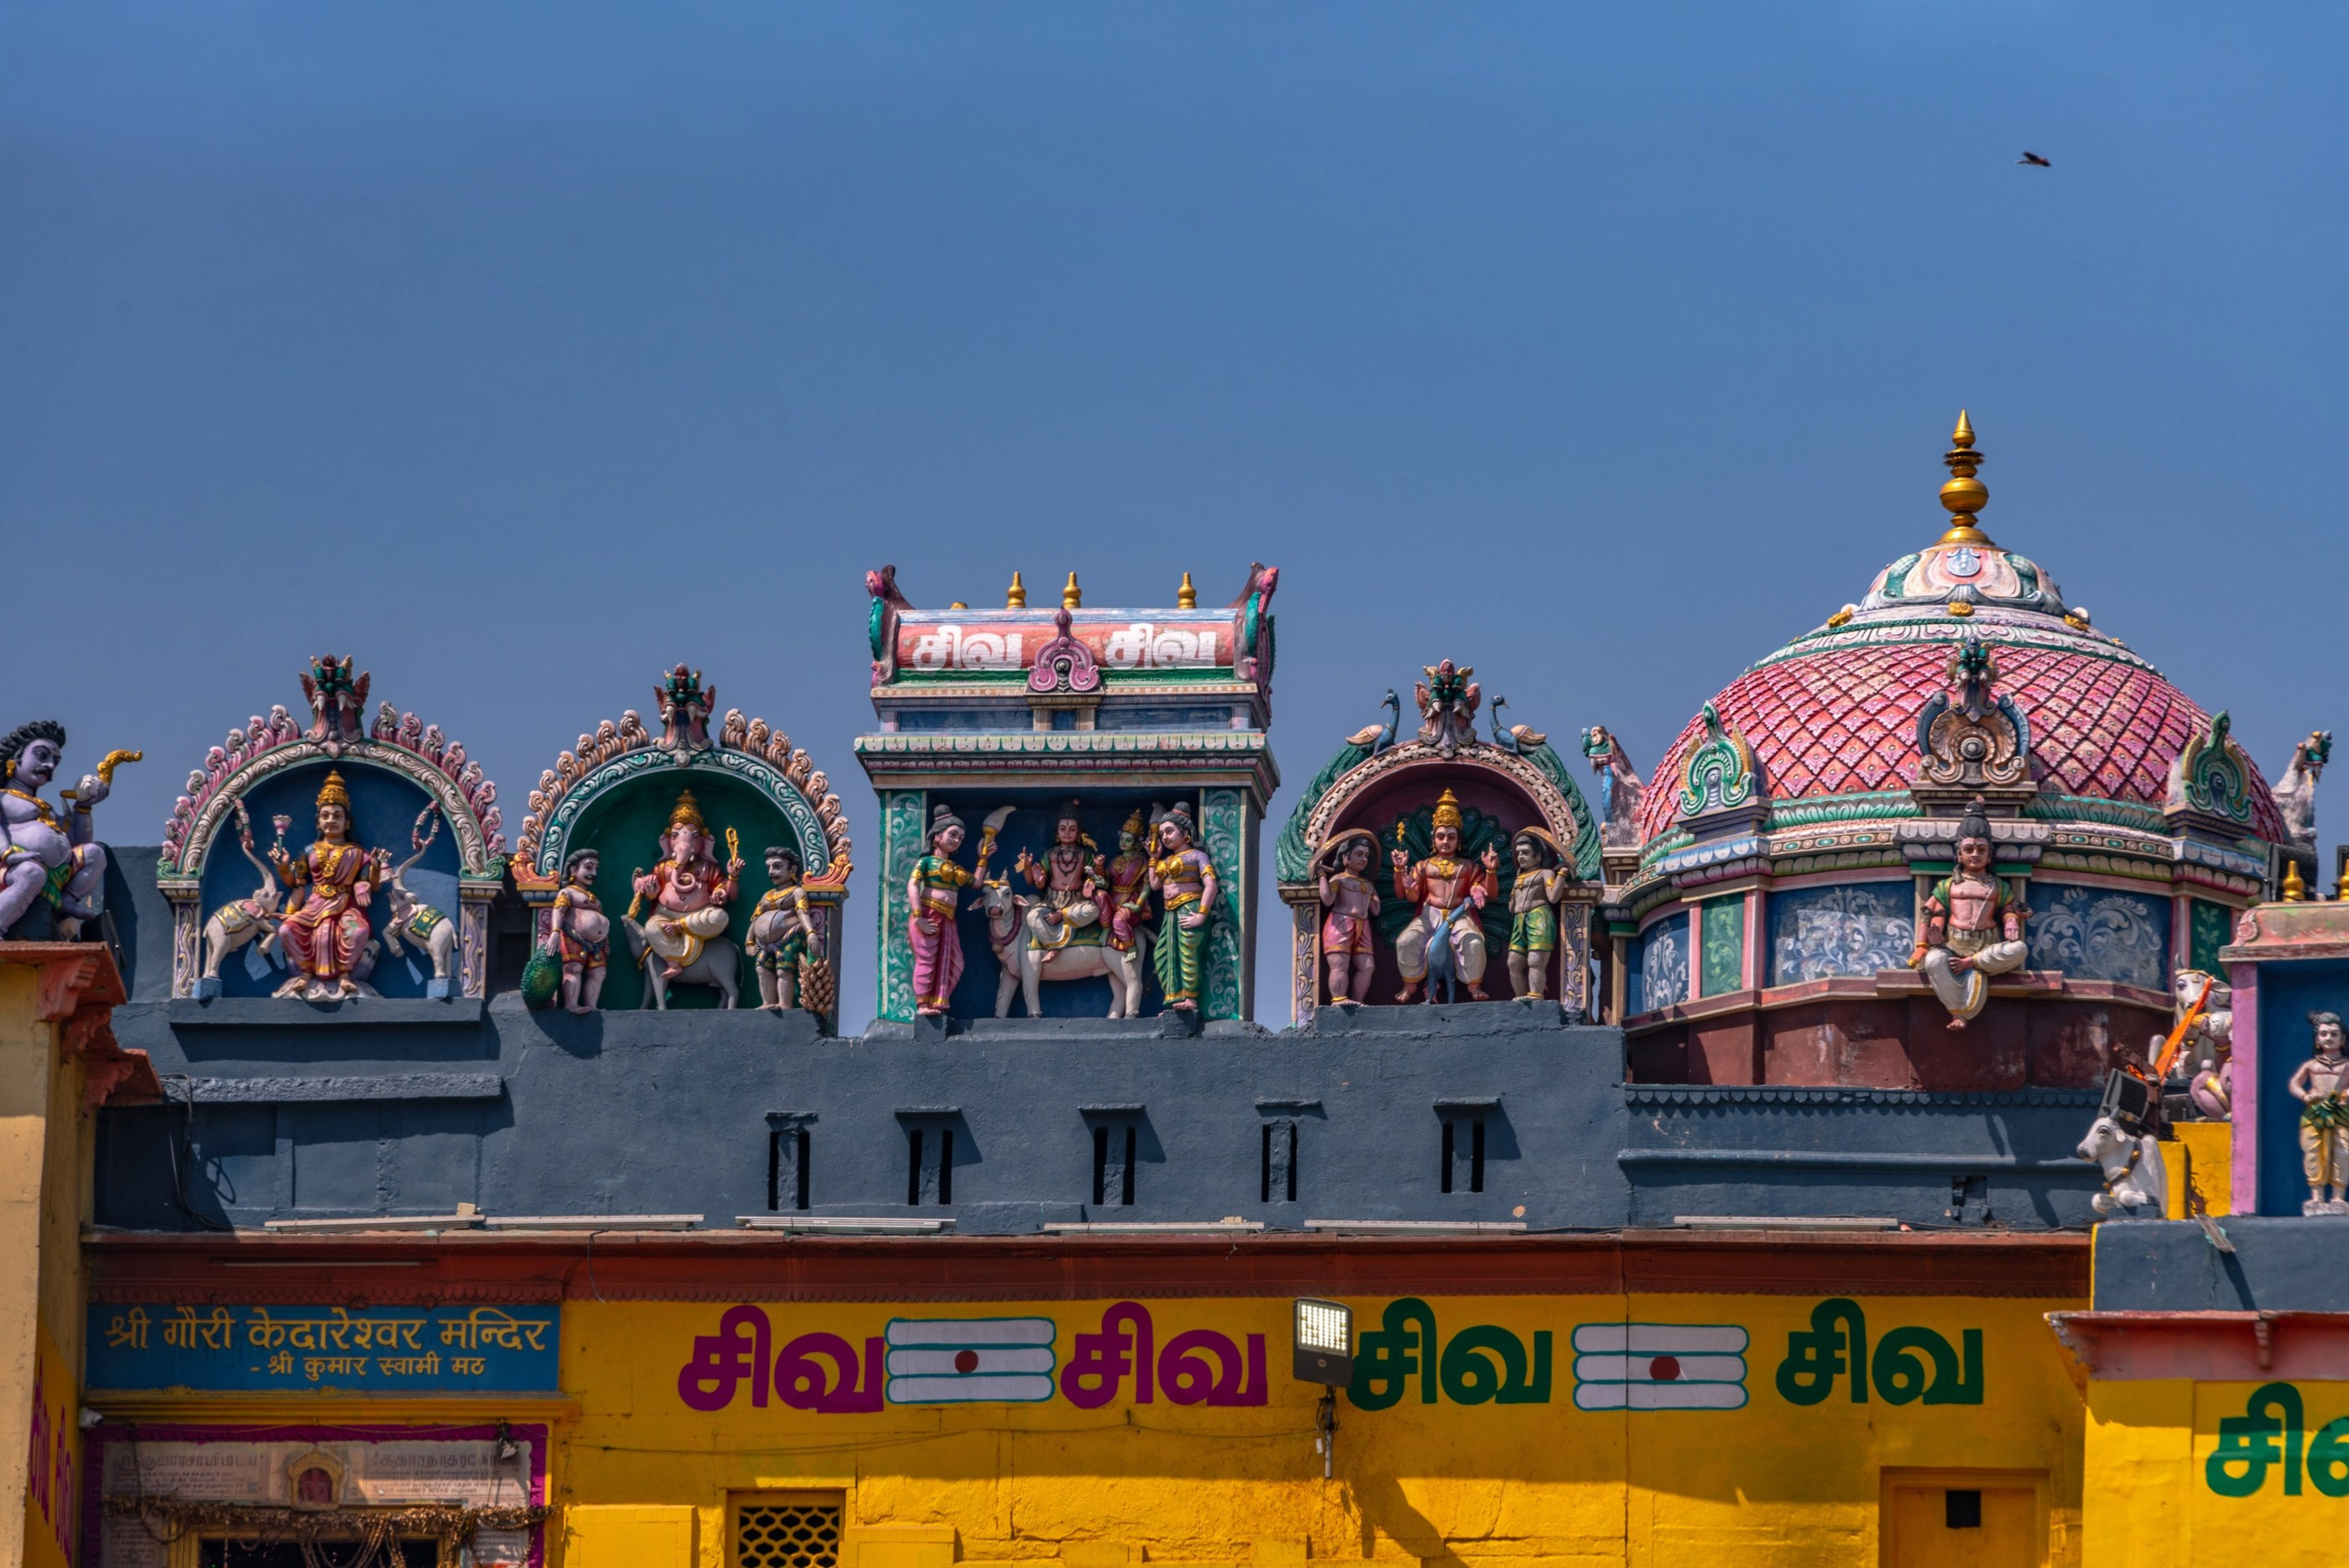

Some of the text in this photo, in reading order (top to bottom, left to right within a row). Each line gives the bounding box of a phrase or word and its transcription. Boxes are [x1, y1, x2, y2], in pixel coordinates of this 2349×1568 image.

[912, 623, 1216, 671] சிவ சிவ
[105, 1306, 552, 1351] श्री गौरी केदारेश्वर मन्दिर
[267, 1351, 295, 1375] श्री
[304, 1357, 369, 1382] कुमार
[376, 1351, 442, 1376] स्वामी
[451, 1357, 487, 1376] मठ
[678, 1301, 1268, 1414] சிவ சிவ
[1346, 1297, 1984, 1411] சிவ சிவ
